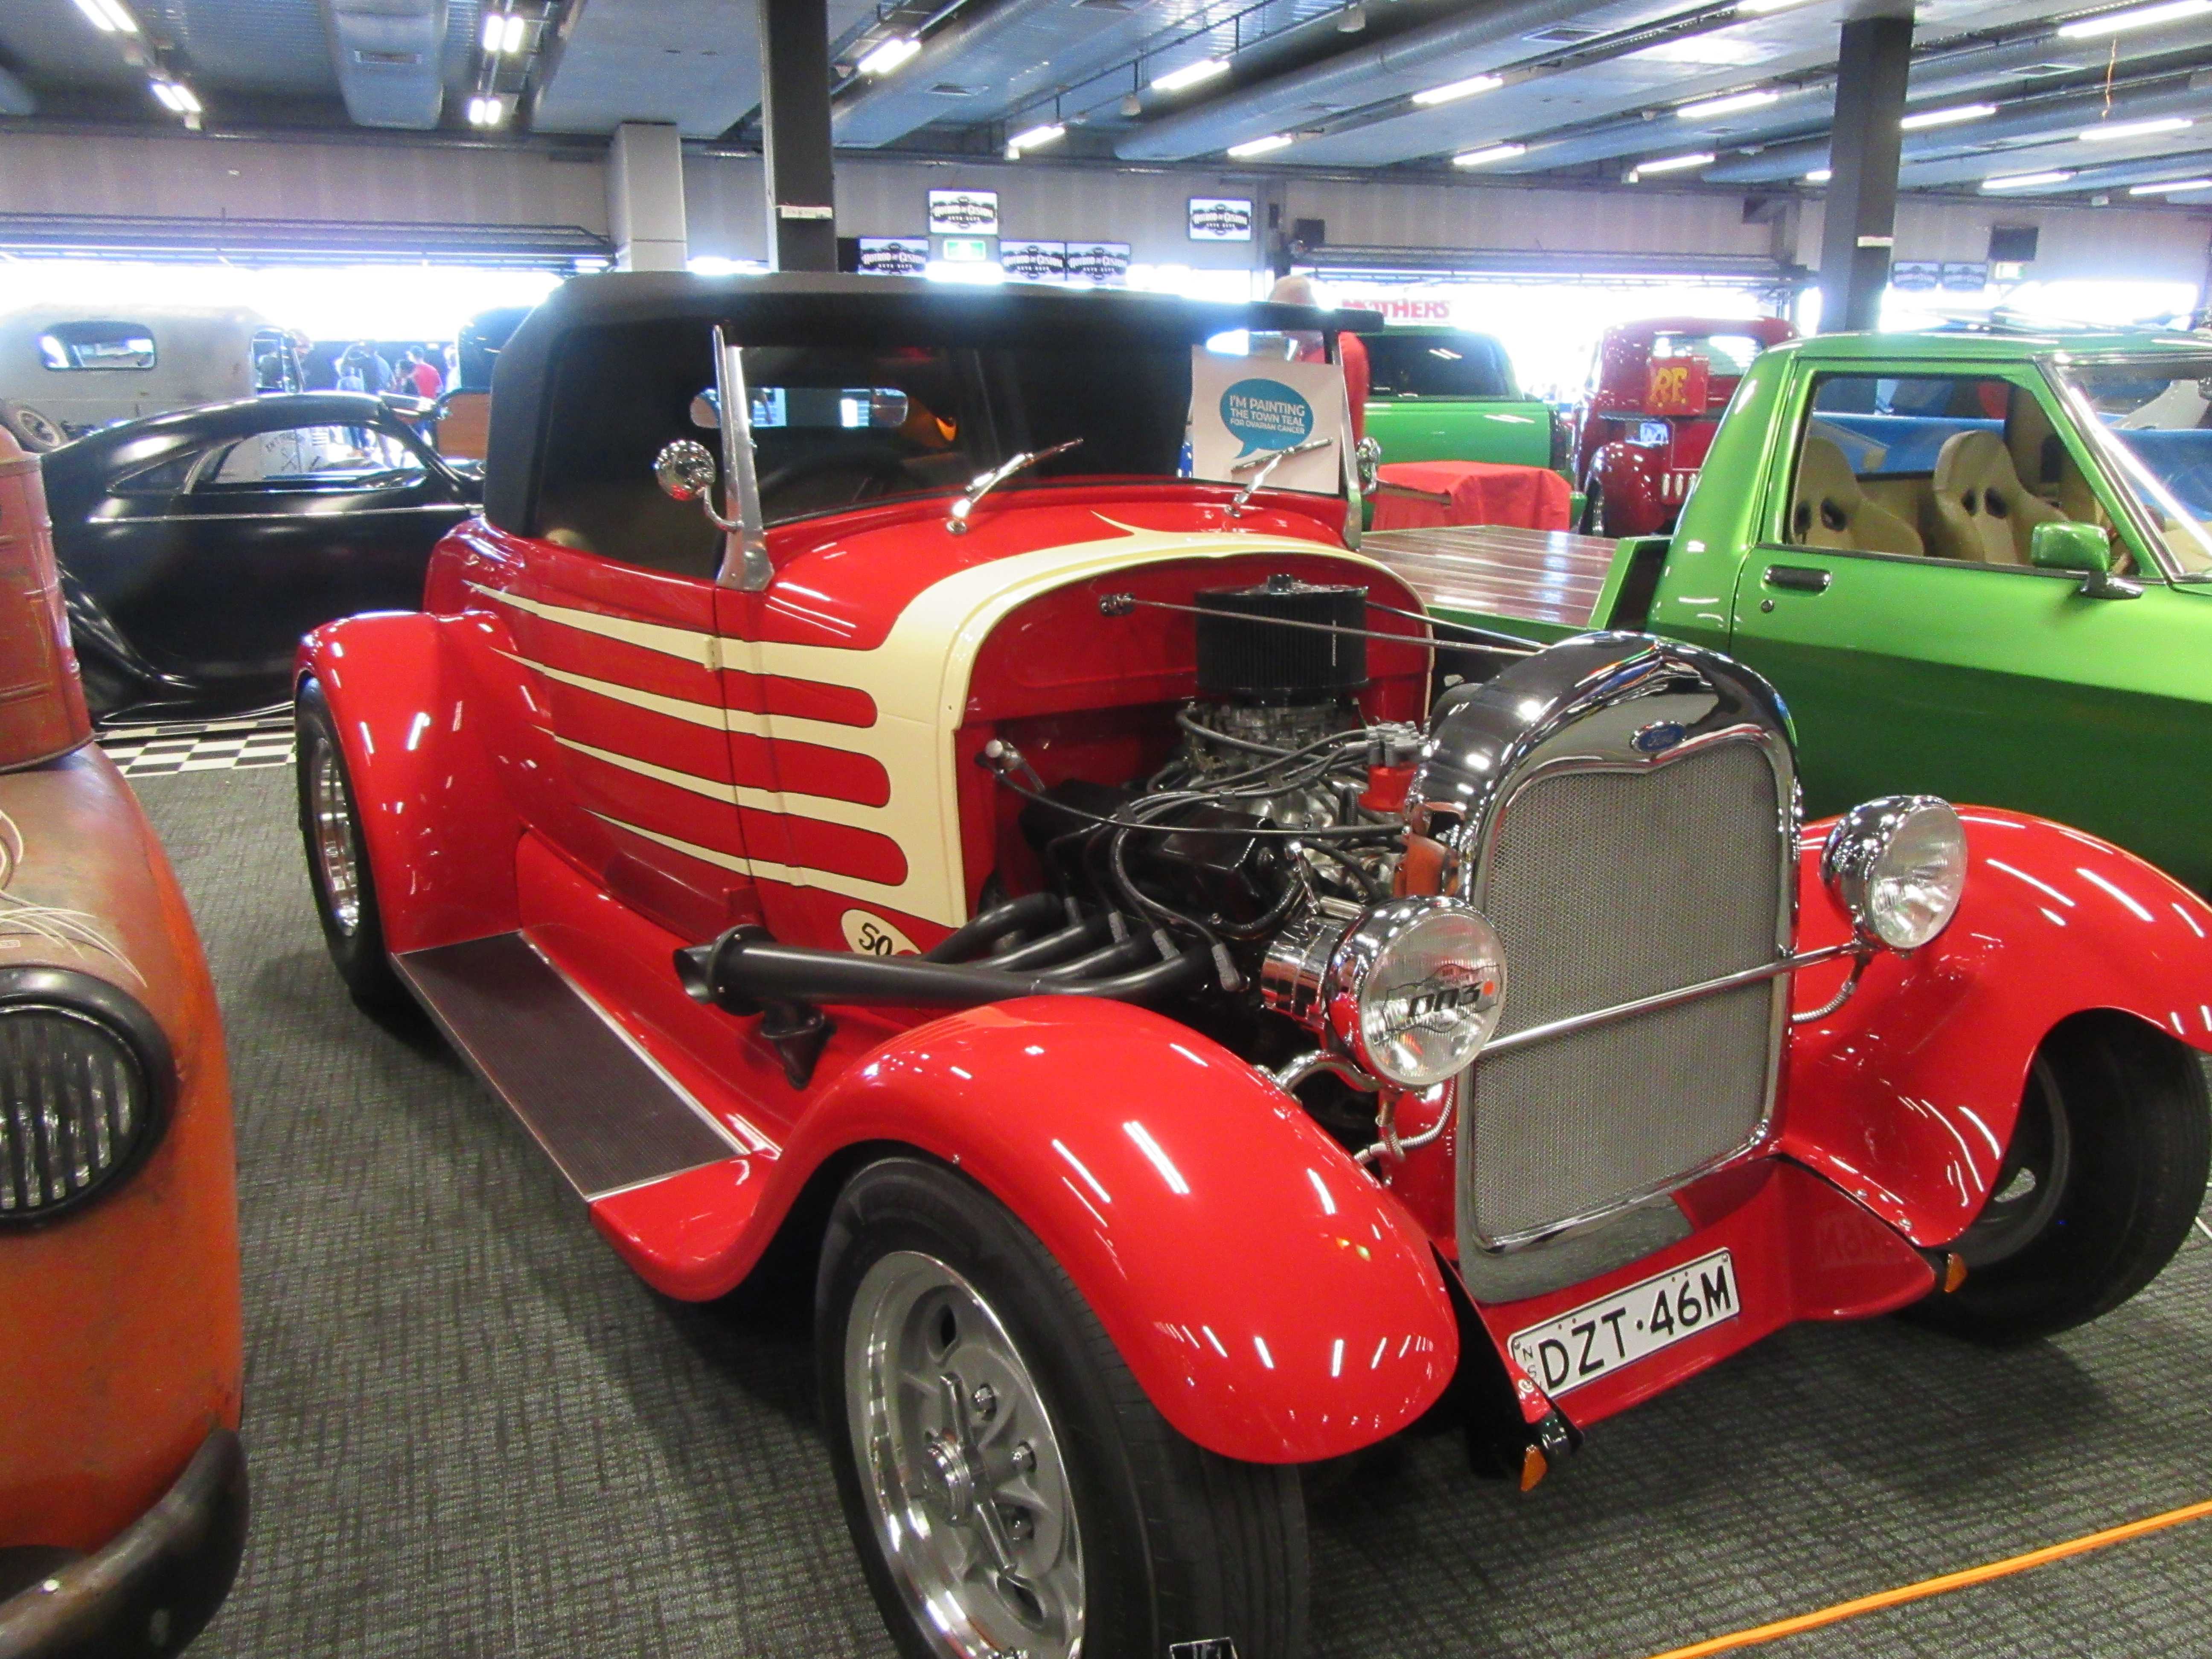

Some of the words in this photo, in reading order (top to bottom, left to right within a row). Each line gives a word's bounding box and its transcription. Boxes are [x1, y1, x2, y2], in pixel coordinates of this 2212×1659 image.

[1230, 395, 1246, 408] I'M
[1250, 397, 1305, 416] PAINTING
[1231, 408, 1249, 419] THE
[1250, 411, 1279, 424] TOWN
[1281, 414, 1305, 427] TEAL
[1231, 418, 1244, 427] FOR
[1246, 420, 1277, 431] OVARIAN
[1278, 425, 1305, 434] CANCER
